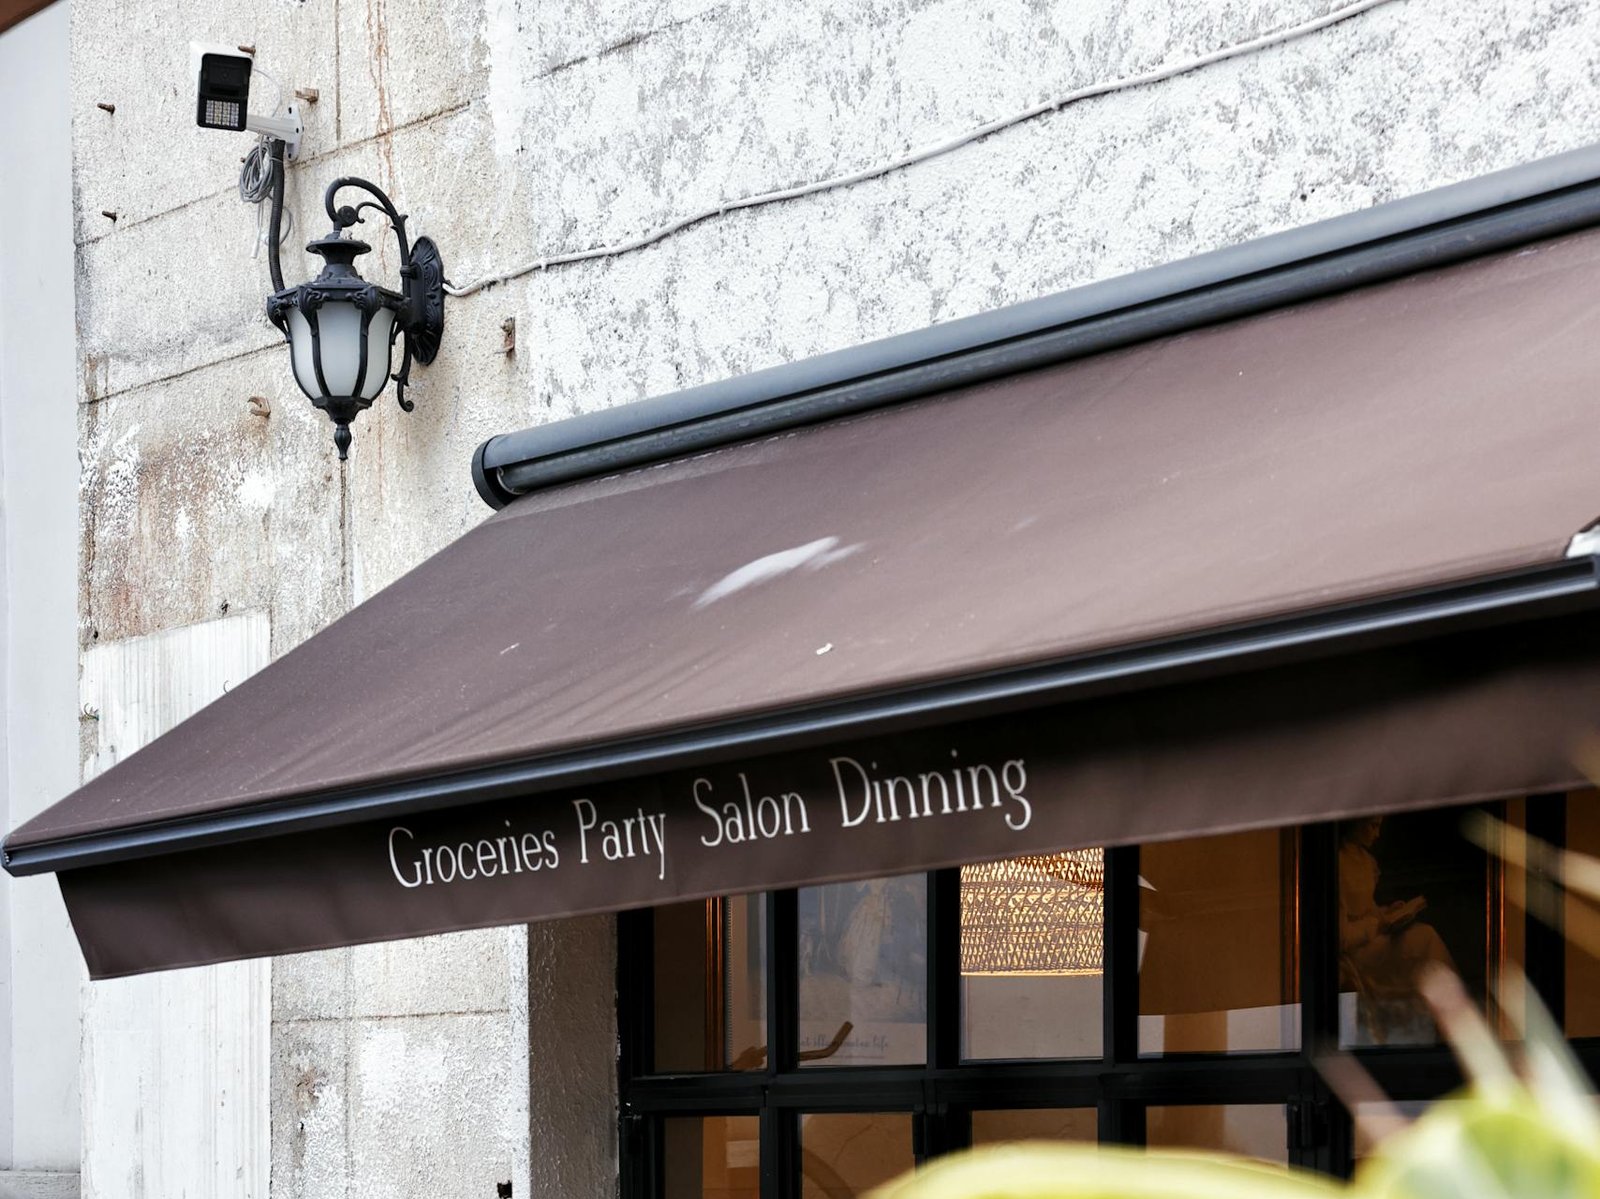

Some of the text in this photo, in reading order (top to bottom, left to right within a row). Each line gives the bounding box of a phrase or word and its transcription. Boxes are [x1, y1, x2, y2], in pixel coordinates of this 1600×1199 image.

[387, 748, 1032, 888] Groceries Party Salon Dinning
